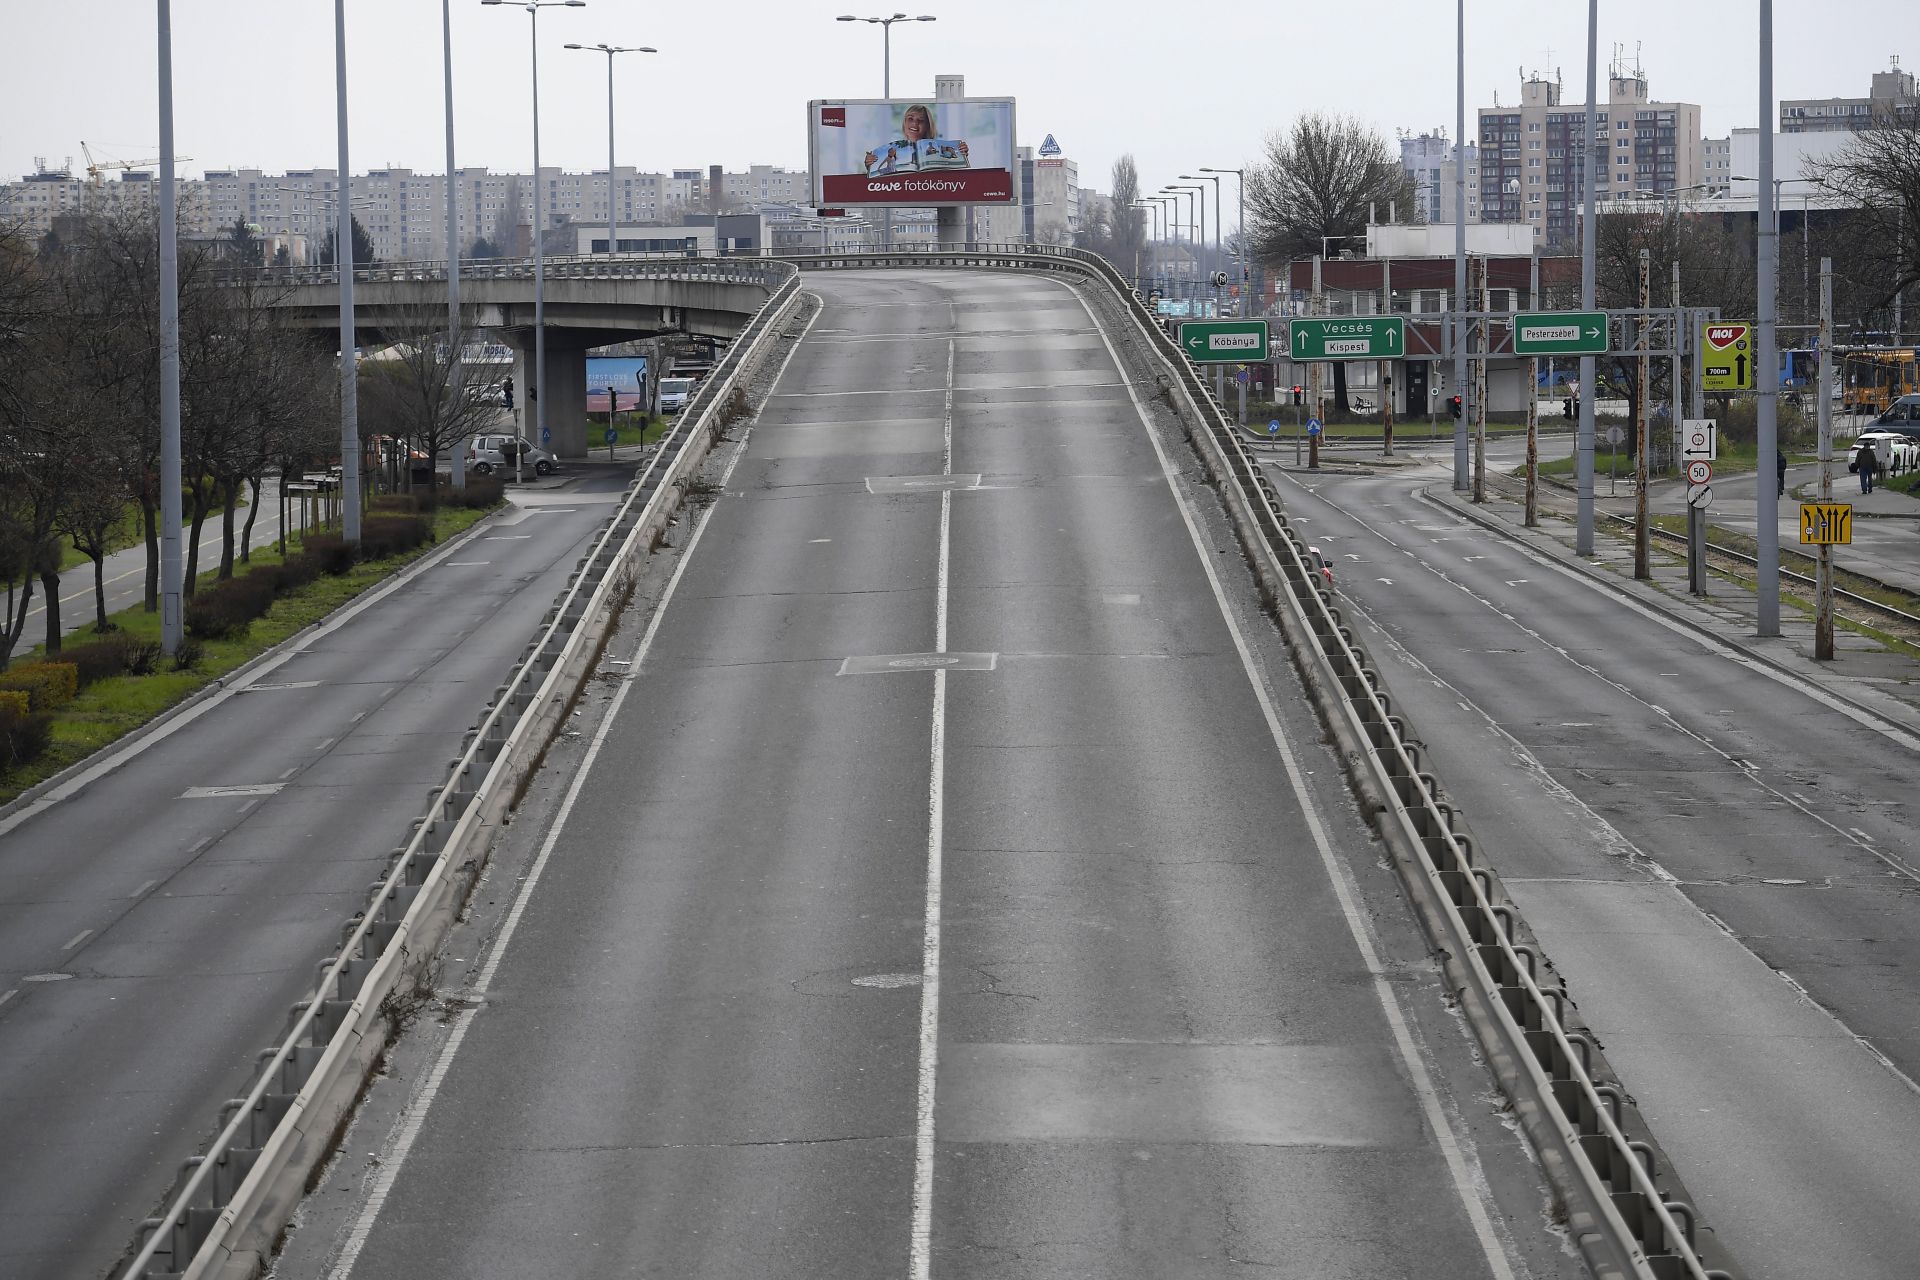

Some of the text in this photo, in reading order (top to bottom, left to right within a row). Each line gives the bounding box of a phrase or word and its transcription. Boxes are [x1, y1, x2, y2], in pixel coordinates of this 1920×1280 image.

[867, 180, 966, 192] cewe fotókönyv
[1322, 323, 1372, 333] Vecsés
[1526, 329, 1575, 339] Pesterzsébet
[1711, 329, 1734, 339] MOL
[1329, 342, 1365, 352] Kispest
[1709, 368, 1728, 376] 700m
[1693, 467, 1705, 477] 50
